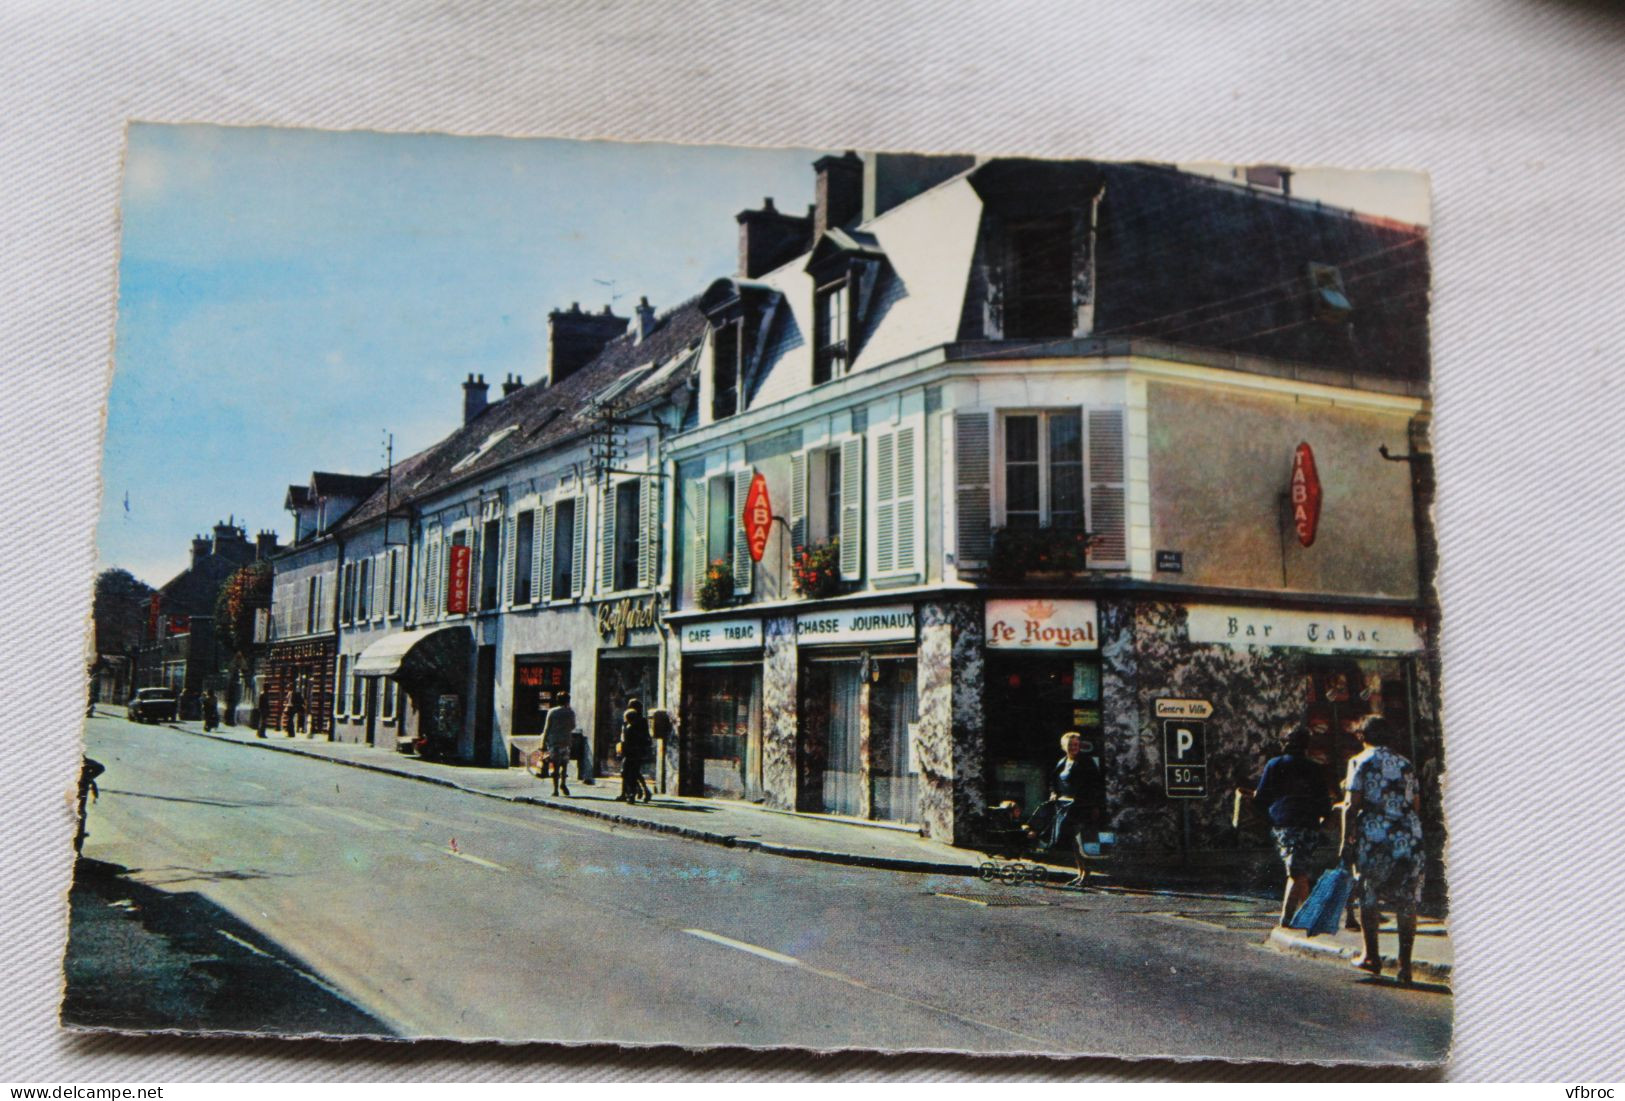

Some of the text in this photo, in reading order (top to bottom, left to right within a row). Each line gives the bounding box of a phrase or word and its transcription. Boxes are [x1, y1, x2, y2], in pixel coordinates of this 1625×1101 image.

[1292, 451, 1308, 536] TABAC
[753, 480, 769, 554] TABAC
[688, 626, 754, 643] CAFE TABAC
[798, 613, 915, 636] CHASSE JOURNAUX
[987, 619, 1095, 647] Le Royal
[1228, 617, 1380, 642] Bar Tabac
[1158, 703, 1207, 714] Centre Ville
[1177, 728, 1194, 760] P
